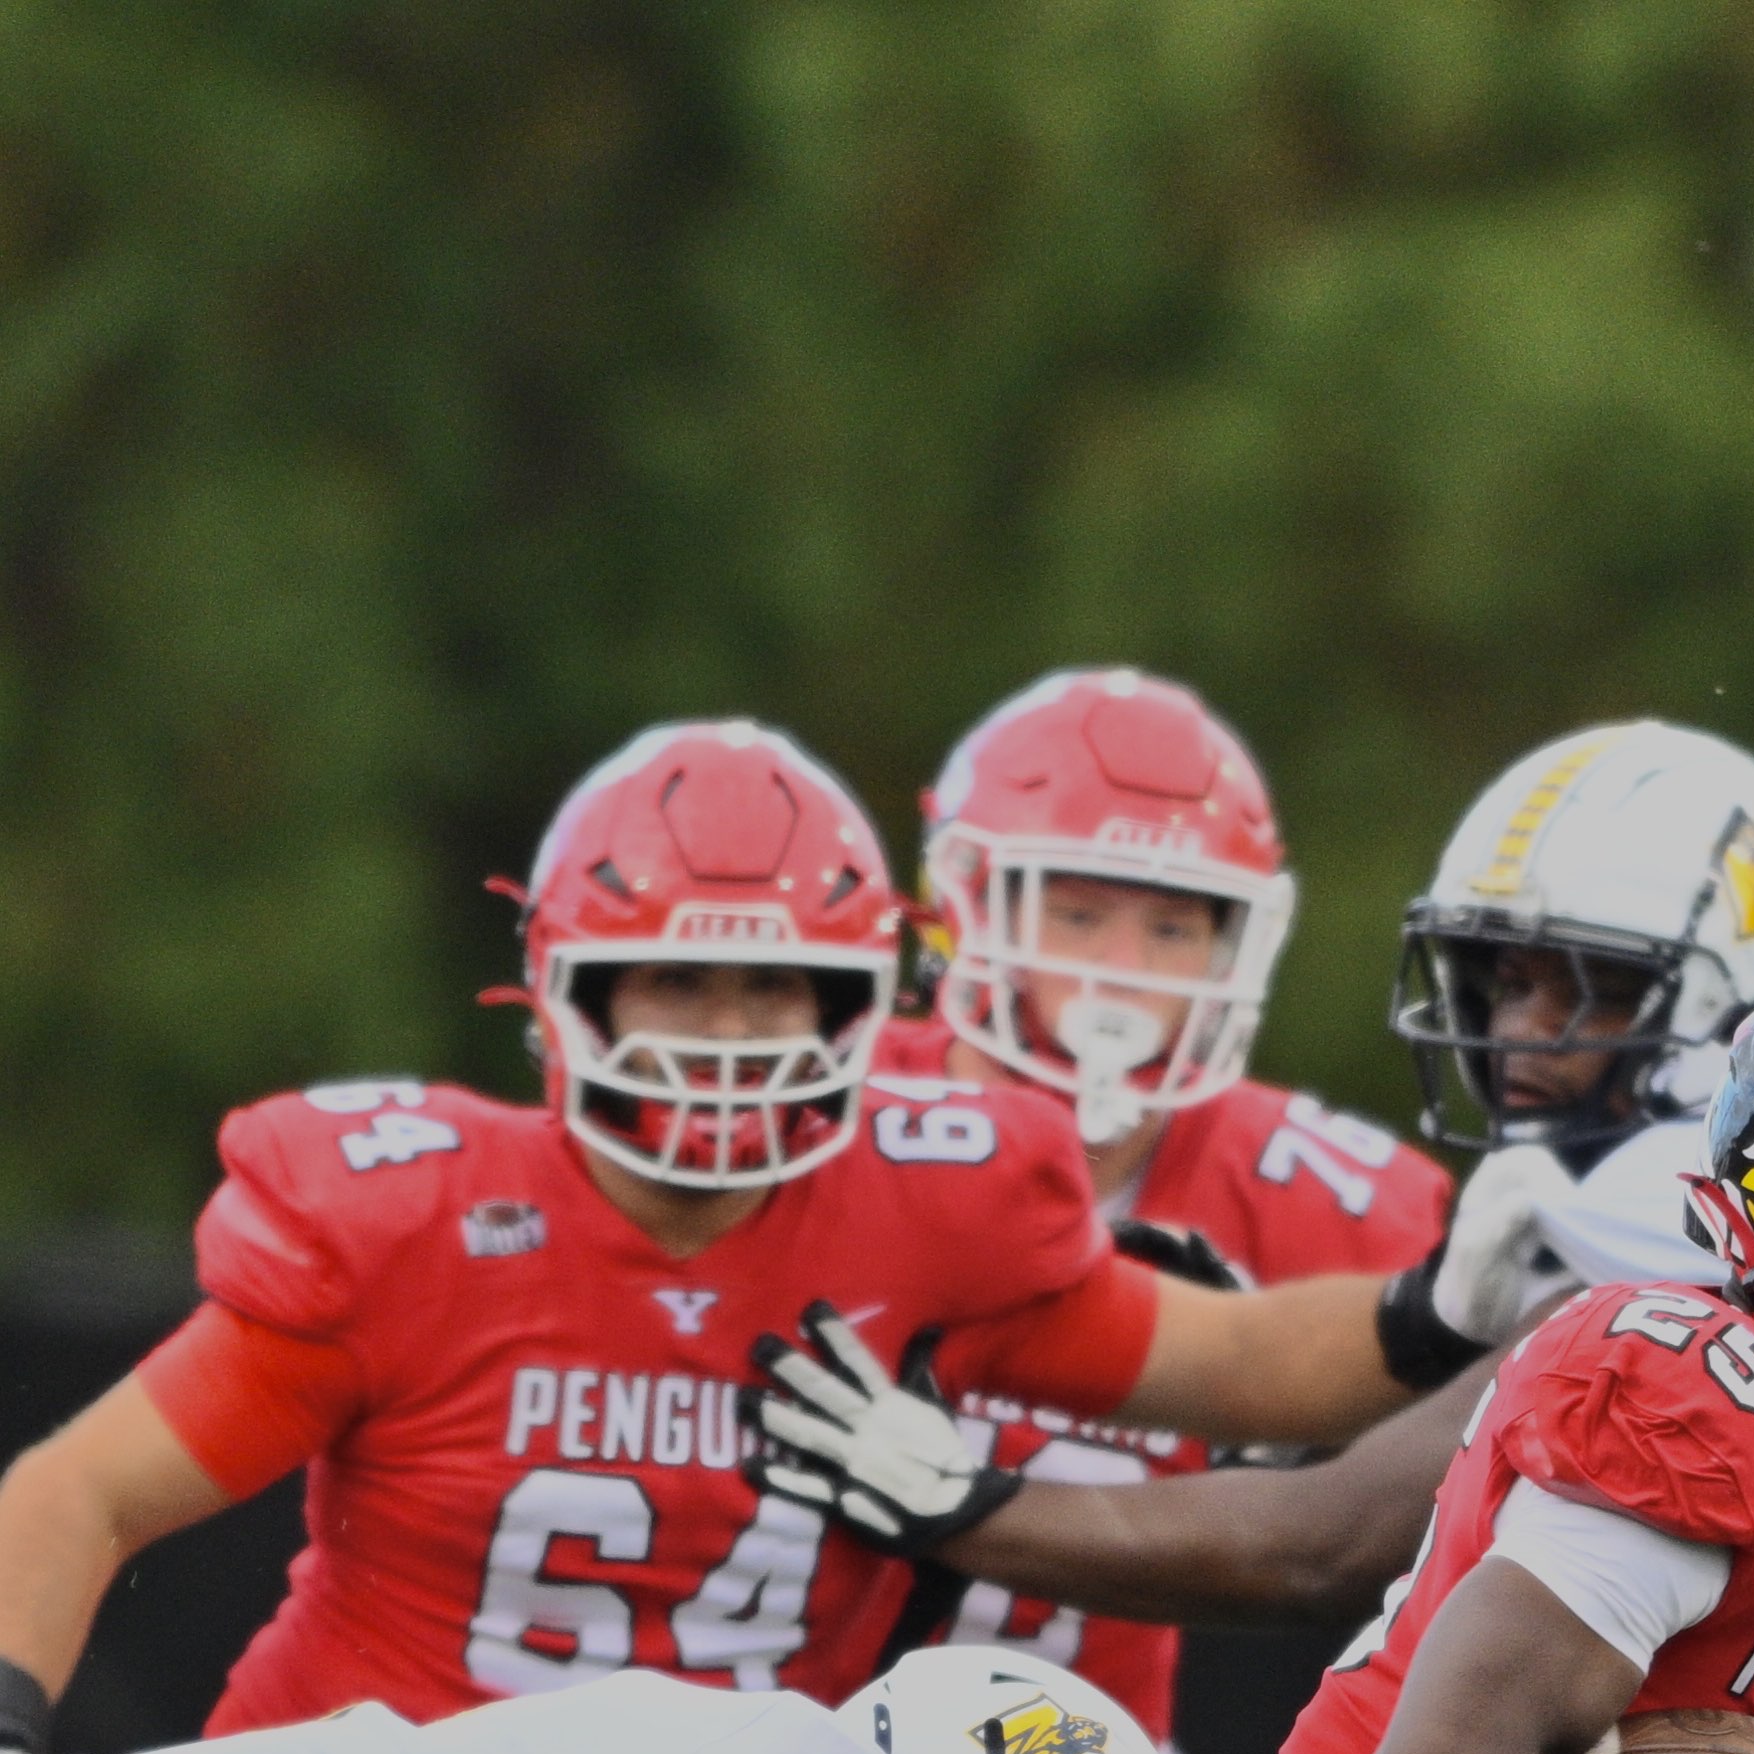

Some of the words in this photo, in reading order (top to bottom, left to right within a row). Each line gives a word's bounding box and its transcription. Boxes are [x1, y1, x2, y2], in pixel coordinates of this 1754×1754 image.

[652, 1291, 717, 1335] Y
[504, 1368, 756, 1469] PENGU
[464, 1466, 826, 1694] 64
